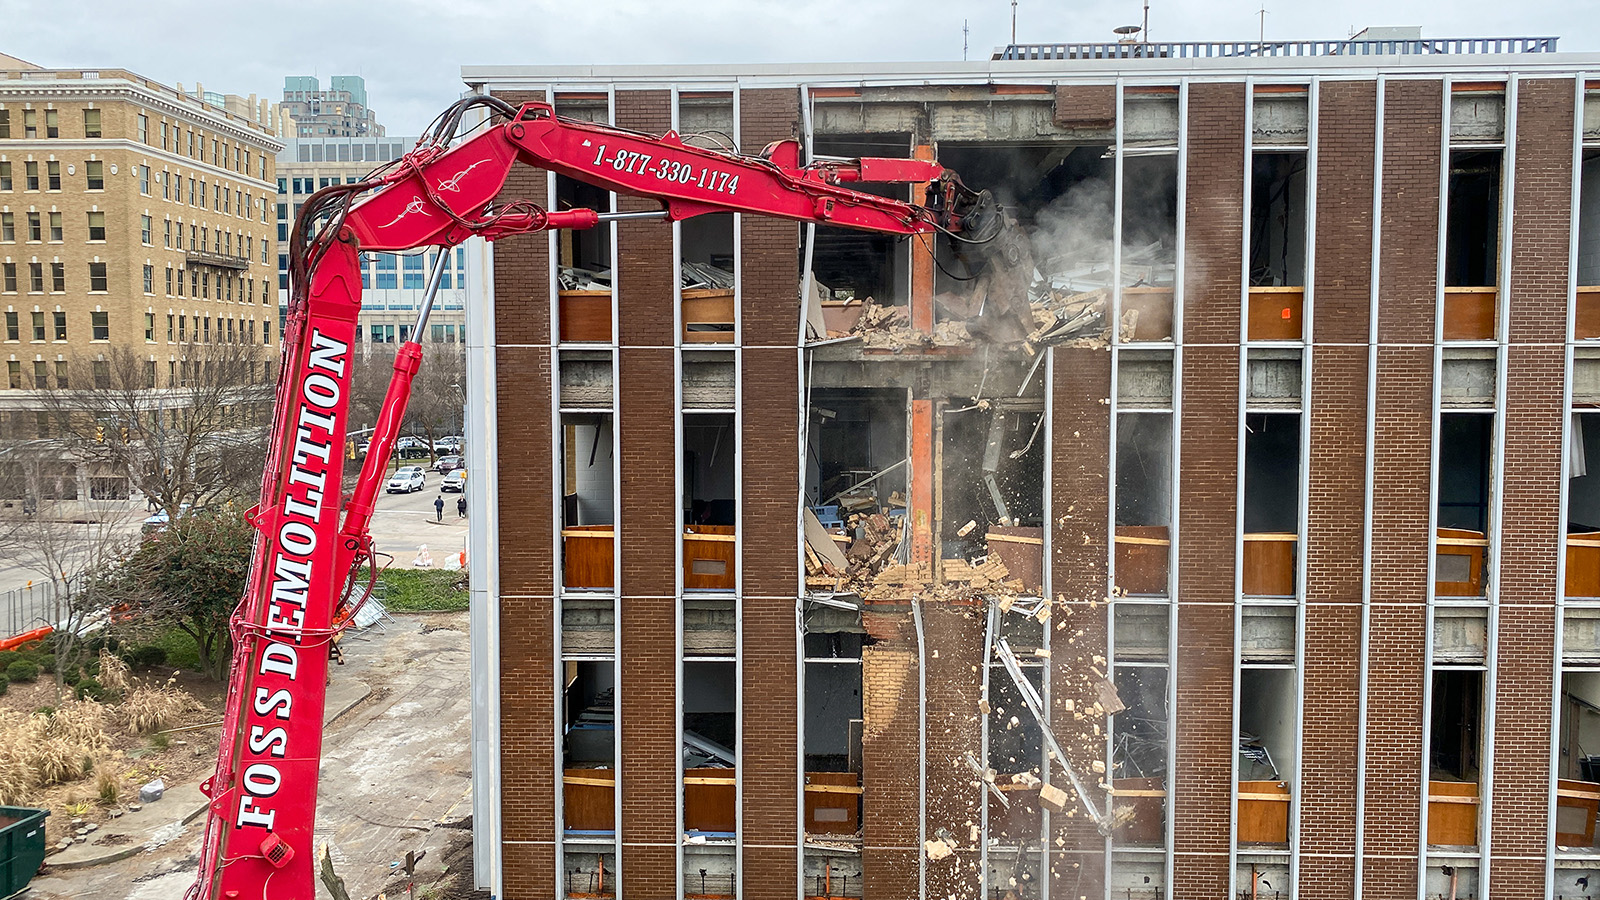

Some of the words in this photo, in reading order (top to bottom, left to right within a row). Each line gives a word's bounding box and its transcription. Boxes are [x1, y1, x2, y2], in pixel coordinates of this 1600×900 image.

[593, 145, 740, 195] 1-877-330-1174
[259, 328, 348, 681] DEMOLITION
[235, 687, 293, 833] FOSS
